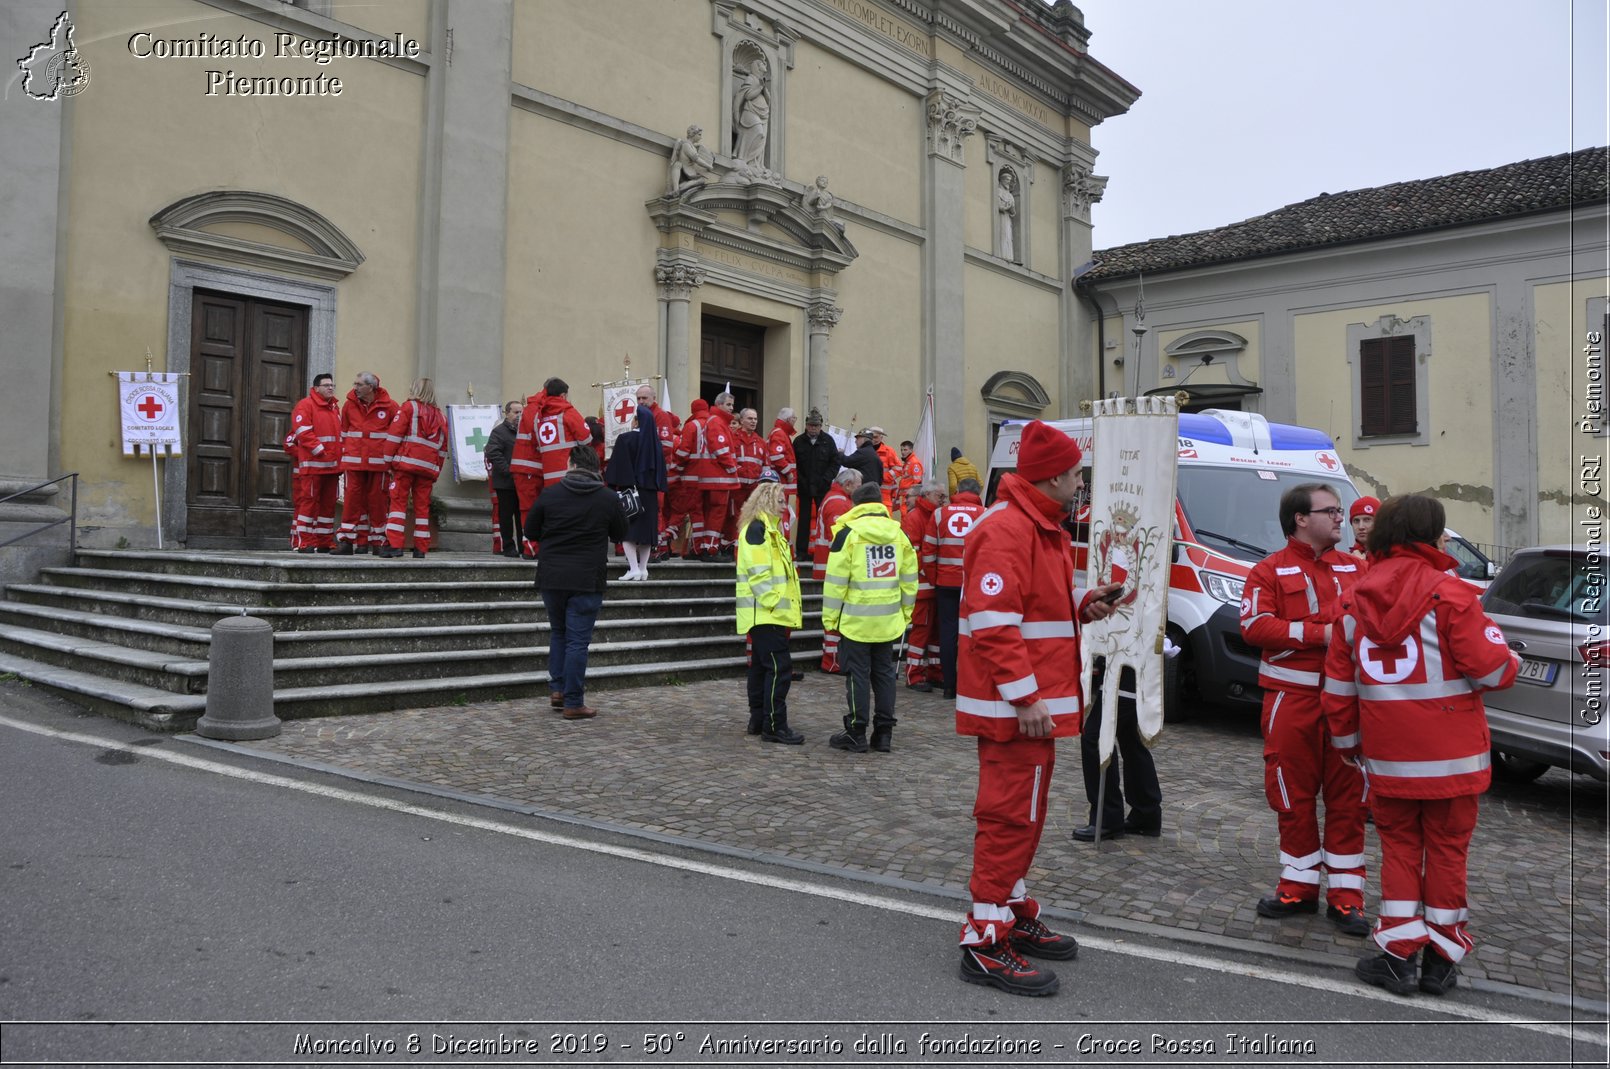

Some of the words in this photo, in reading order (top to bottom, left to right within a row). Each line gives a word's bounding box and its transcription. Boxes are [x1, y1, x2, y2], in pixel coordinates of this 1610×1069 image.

[1230, 456, 1257, 464] Rescue
[1121, 465, 1129, 476] DI
[870, 545, 895, 560] 118
